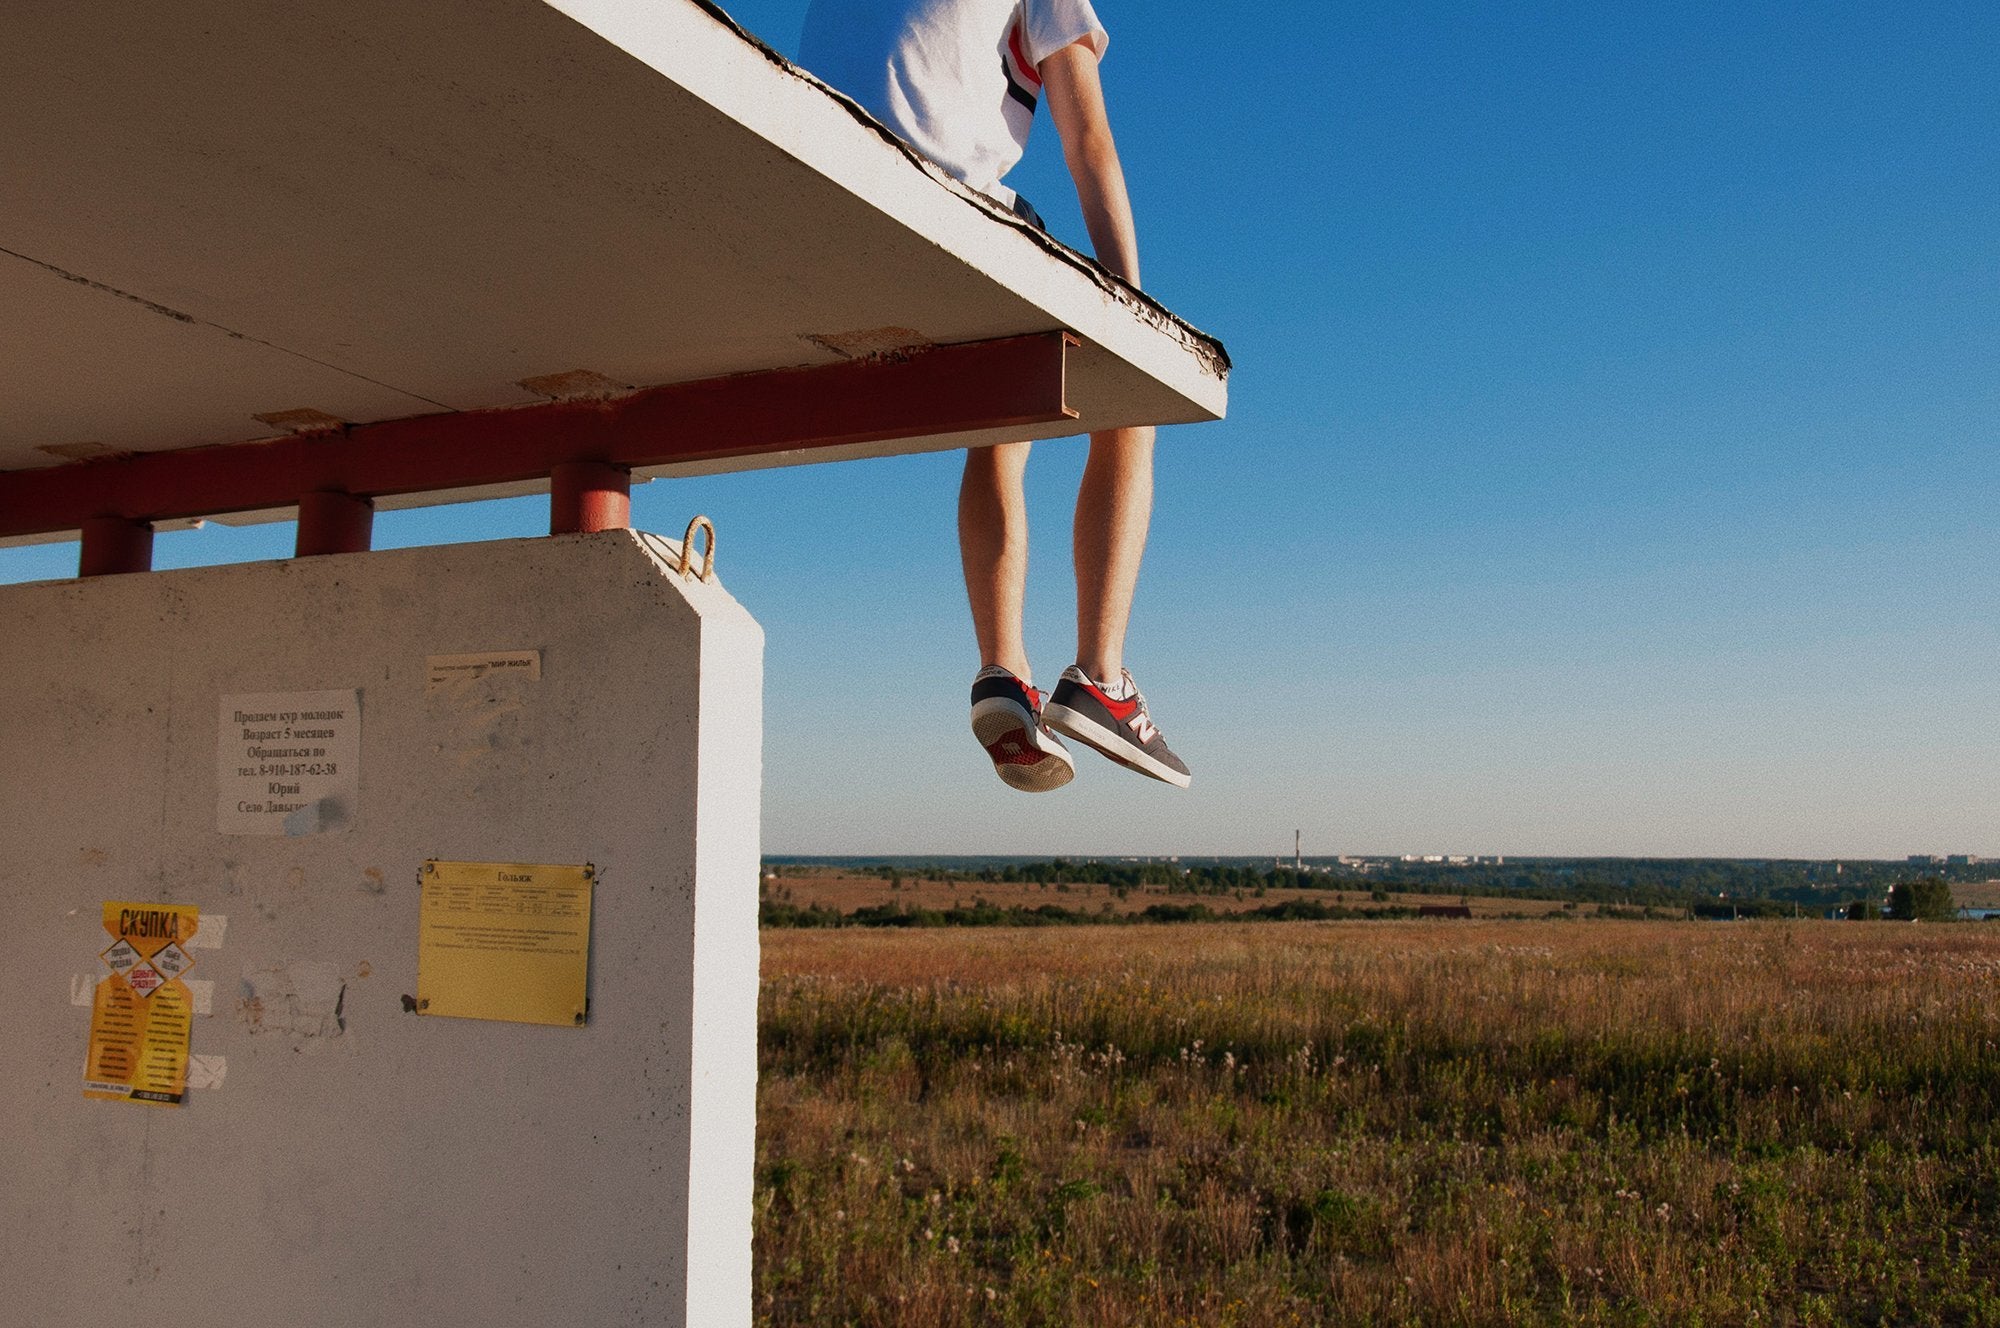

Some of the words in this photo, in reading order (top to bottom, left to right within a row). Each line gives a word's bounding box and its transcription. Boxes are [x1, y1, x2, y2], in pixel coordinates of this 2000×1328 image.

[234, 711, 276, 725] Продаем
[280, 711, 297, 724] кур
[301, 710, 344, 721] молодок
[243, 729, 281, 743] Возраст
[284, 728, 291, 739] 5
[294, 729, 335, 740] месяцев
[1126, 711, 1157, 745] N
[247, 747, 310, 761] Обращаться
[313, 748, 326, 757] по
[238, 766, 257, 777] тел.
[259, 763, 337, 776] 8-910-187-62-38
[268, 782, 300, 797] Юрий
[237, 801, 262, 814] Село
[497, 871, 533, 883] Гольяж
[120, 909, 178, 939] СКУПКА
